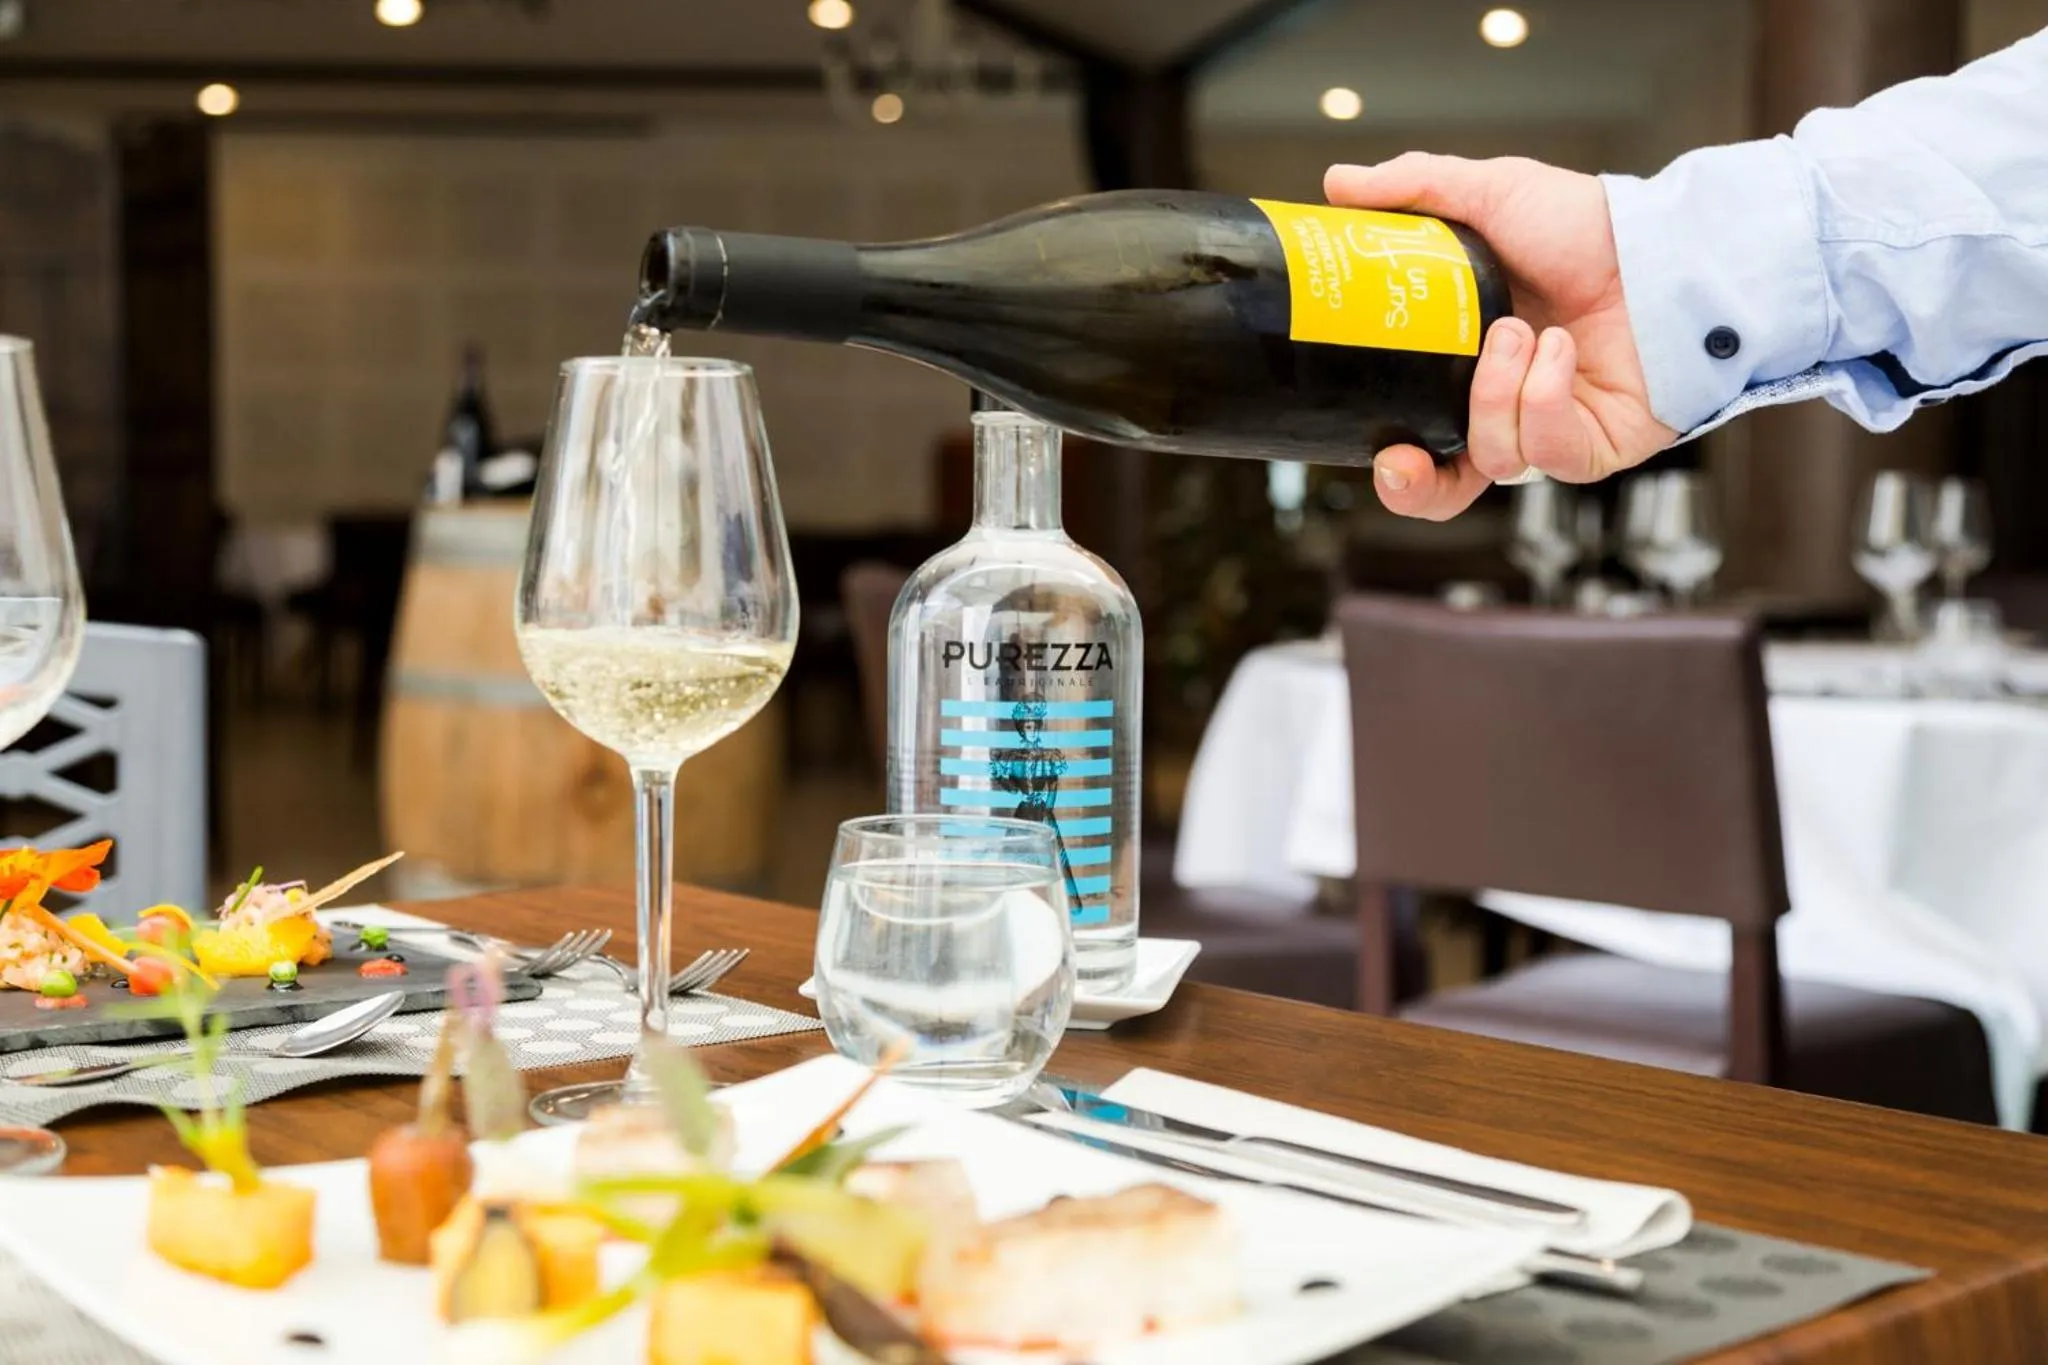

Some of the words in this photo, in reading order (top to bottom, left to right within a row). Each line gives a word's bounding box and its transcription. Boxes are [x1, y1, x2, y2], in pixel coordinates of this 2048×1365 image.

[1407, 267, 1429, 300] un
[1386, 274, 1409, 329] Sur
[942, 640, 1114, 672] PUREZZA
